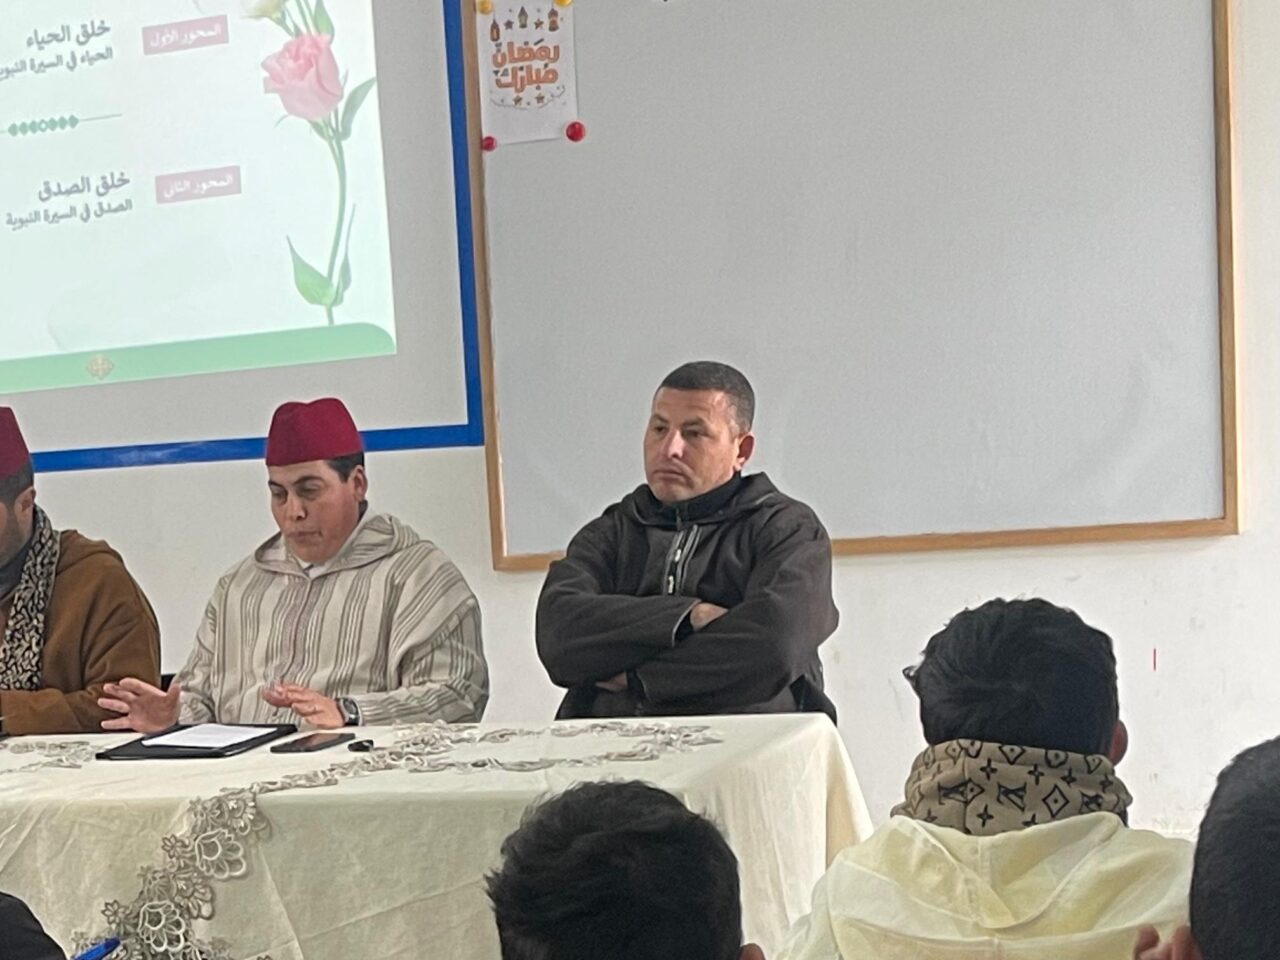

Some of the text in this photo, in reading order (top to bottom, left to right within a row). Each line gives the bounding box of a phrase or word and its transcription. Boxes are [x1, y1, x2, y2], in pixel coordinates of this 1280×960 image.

[26, 19, 111, 50] خلق الحياء
[181, 23, 222, 45] المحور
[29, 55, 64, 74] السيرة
[66, 51, 78, 72] في
[80, 46, 113, 66] الحياء
[38, 171, 131, 202] خلق الصدق
[191, 173, 233, 195] المحور
[5, 198, 133, 231] الصدق في السيرة النبوية
